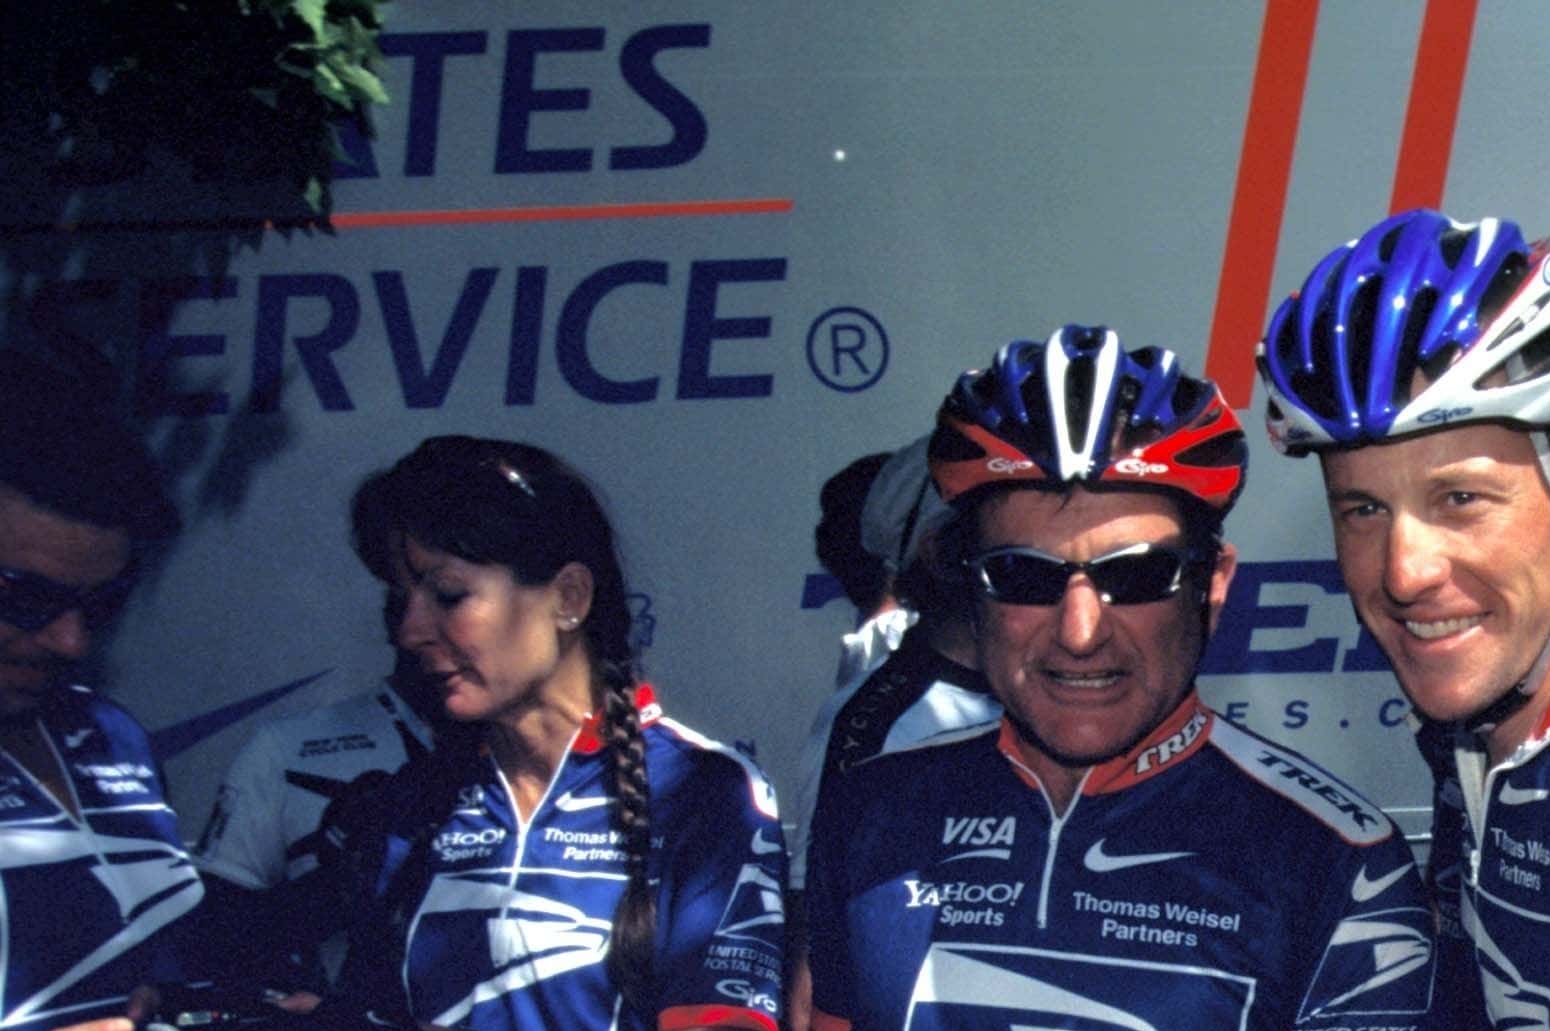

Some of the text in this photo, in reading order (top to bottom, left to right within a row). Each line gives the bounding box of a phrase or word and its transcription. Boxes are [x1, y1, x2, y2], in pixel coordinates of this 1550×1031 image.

[331, 24, 711, 178] TES
[1417, 405, 1473, 424] Giro
[987, 458, 1034, 474] Giro
[1114, 458, 1169, 476] Giro
[1256, 750, 1379, 832] TREK
[543, 828, 608, 845] Thomas
[942, 817, 1016, 845] VISA
[904, 879, 1024, 908] YAHOO!
[940, 905, 1004, 927] Sports
[1073, 891, 1241, 932] Thomas Weisel
[1101, 918, 1199, 947] Partners
[715, 979, 777, 1014] Giro
